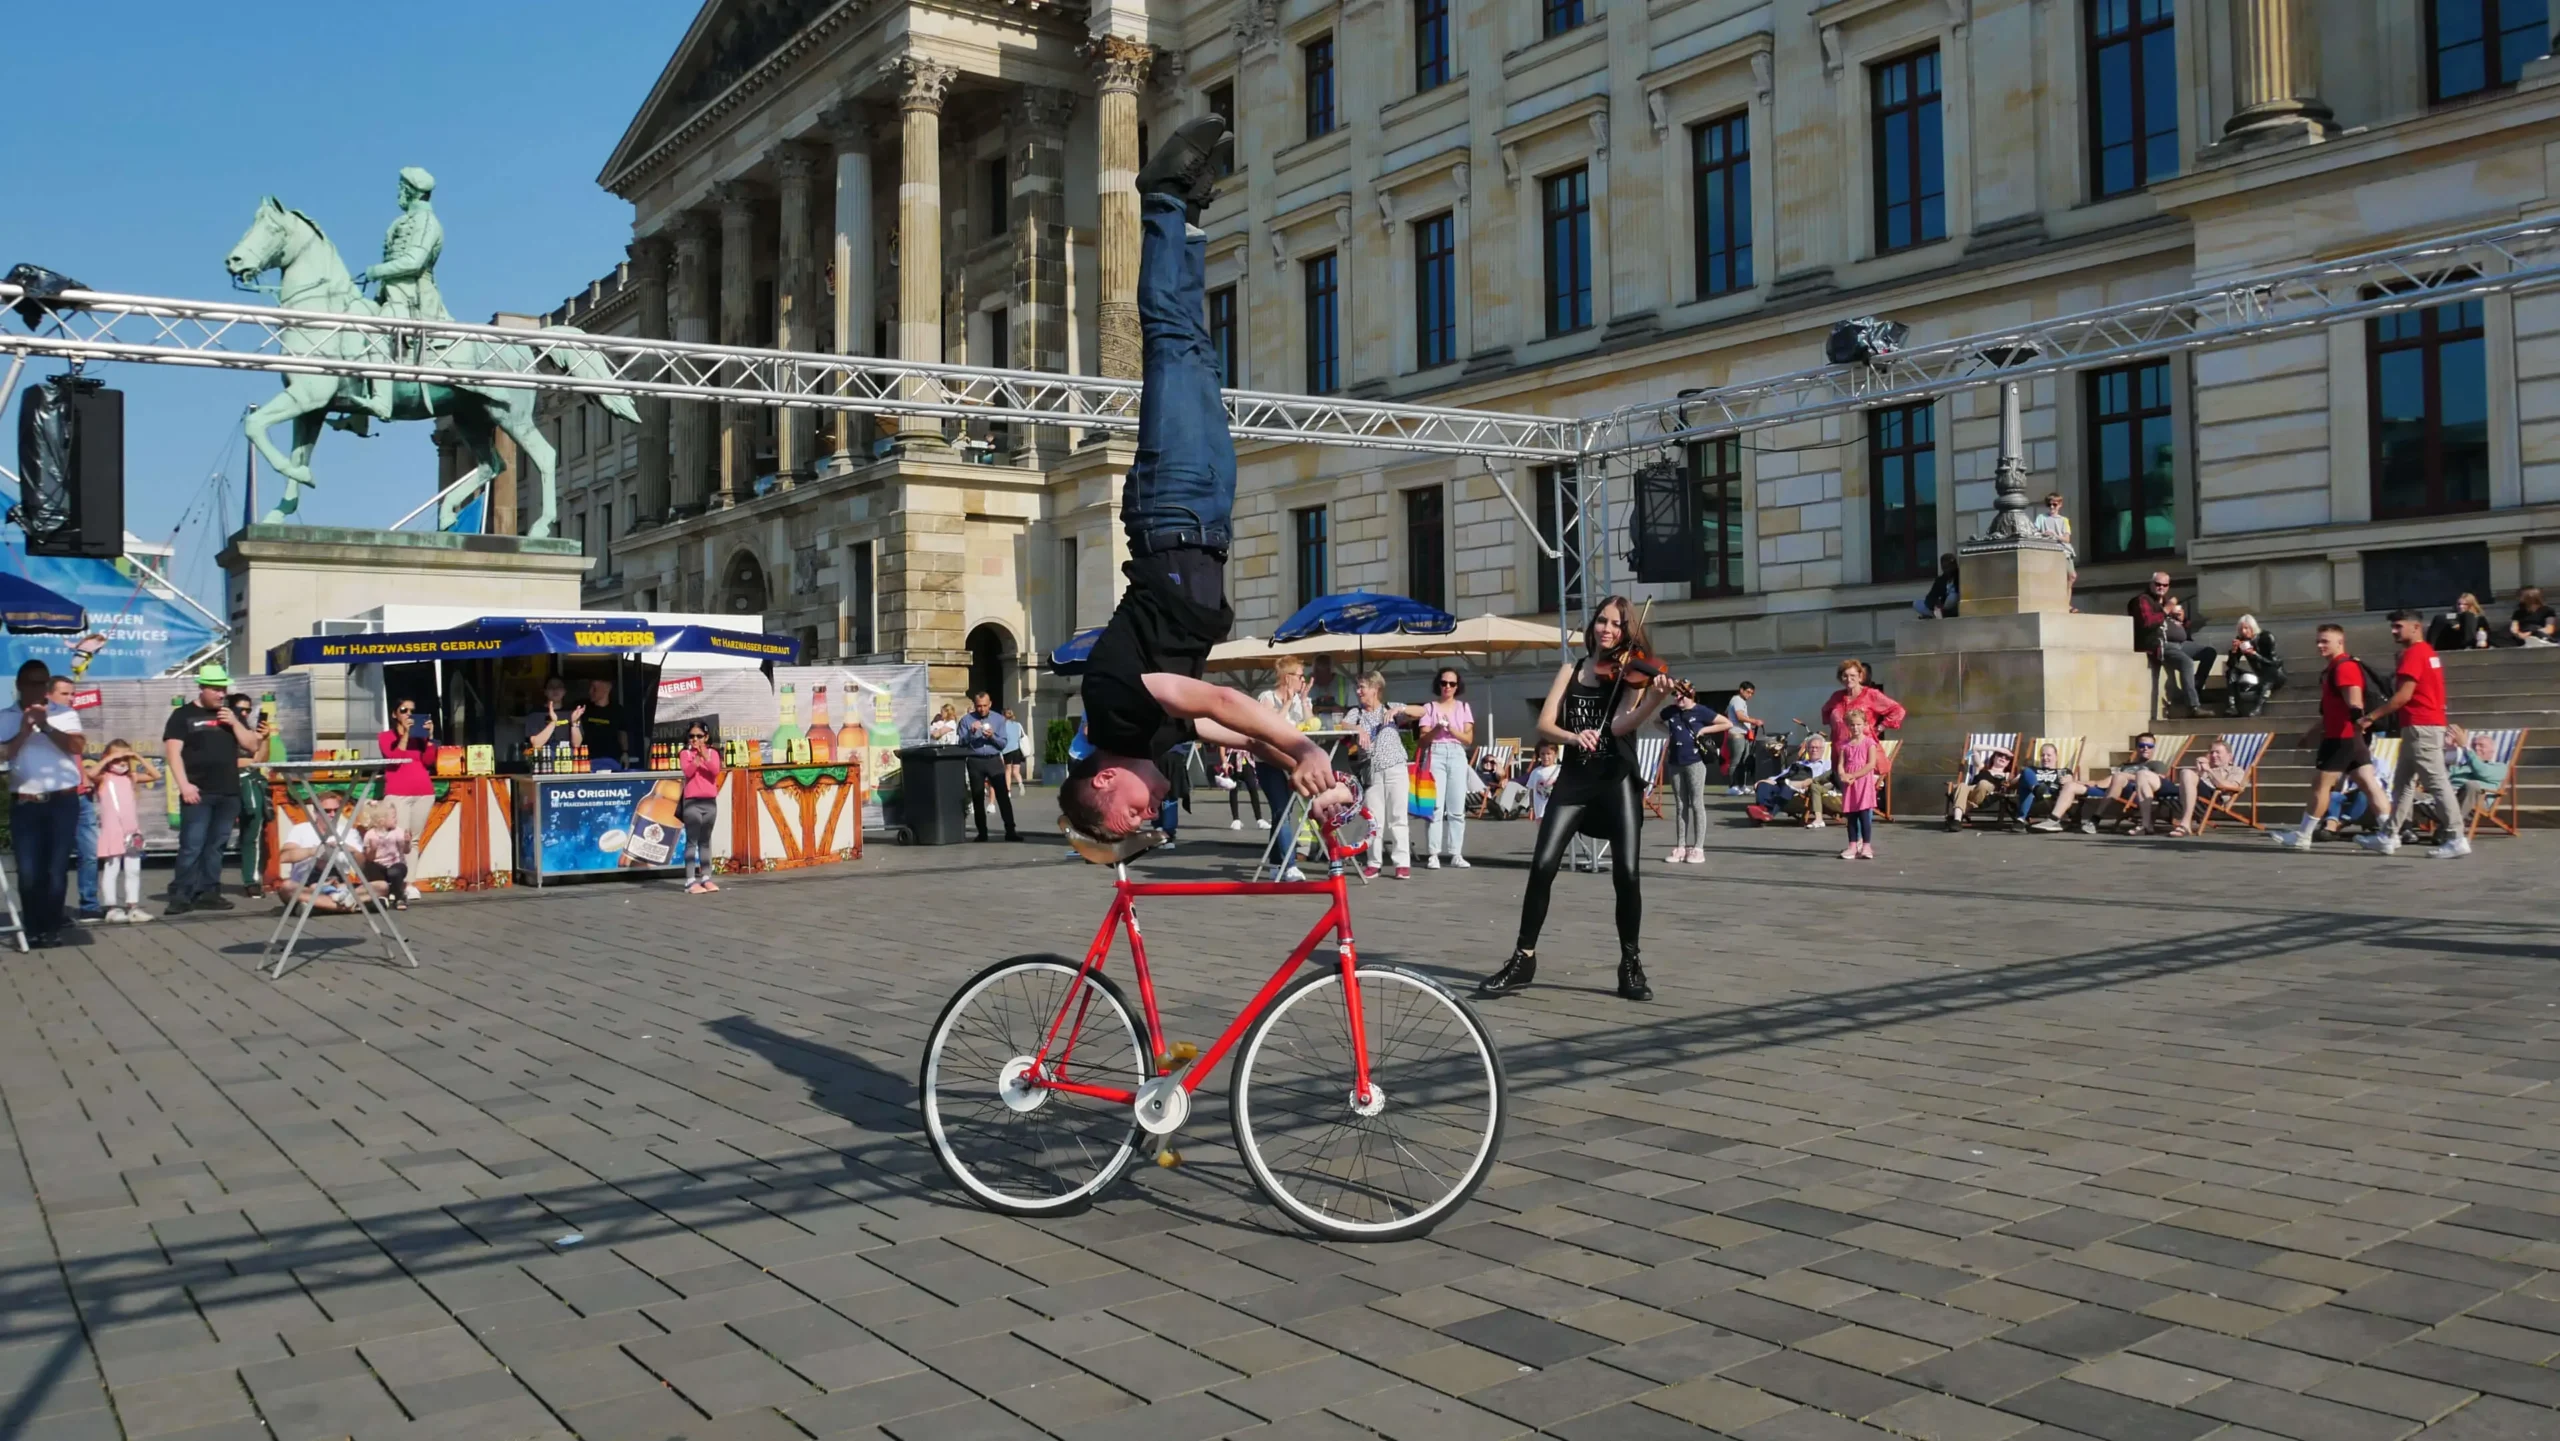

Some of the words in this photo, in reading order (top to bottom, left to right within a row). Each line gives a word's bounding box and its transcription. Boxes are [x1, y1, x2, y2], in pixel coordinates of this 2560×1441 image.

[101, 630, 168, 642] SERVICES
[574, 631, 656, 647] WOLTERS
[322, 645, 347, 656] MIT
[350, 642, 437, 655] HARZWASSER
[440, 639, 502, 651] GEBRAUT
[722, 638, 762, 652] HARZWASSER
[762, 644, 790, 655] GEBRAUT
[1578, 698, 1595, 707] DO
[1568, 707, 1604, 717] SMALL
[551, 789, 575, 799] DAS
[577, 788, 632, 798] ORIGINAL
